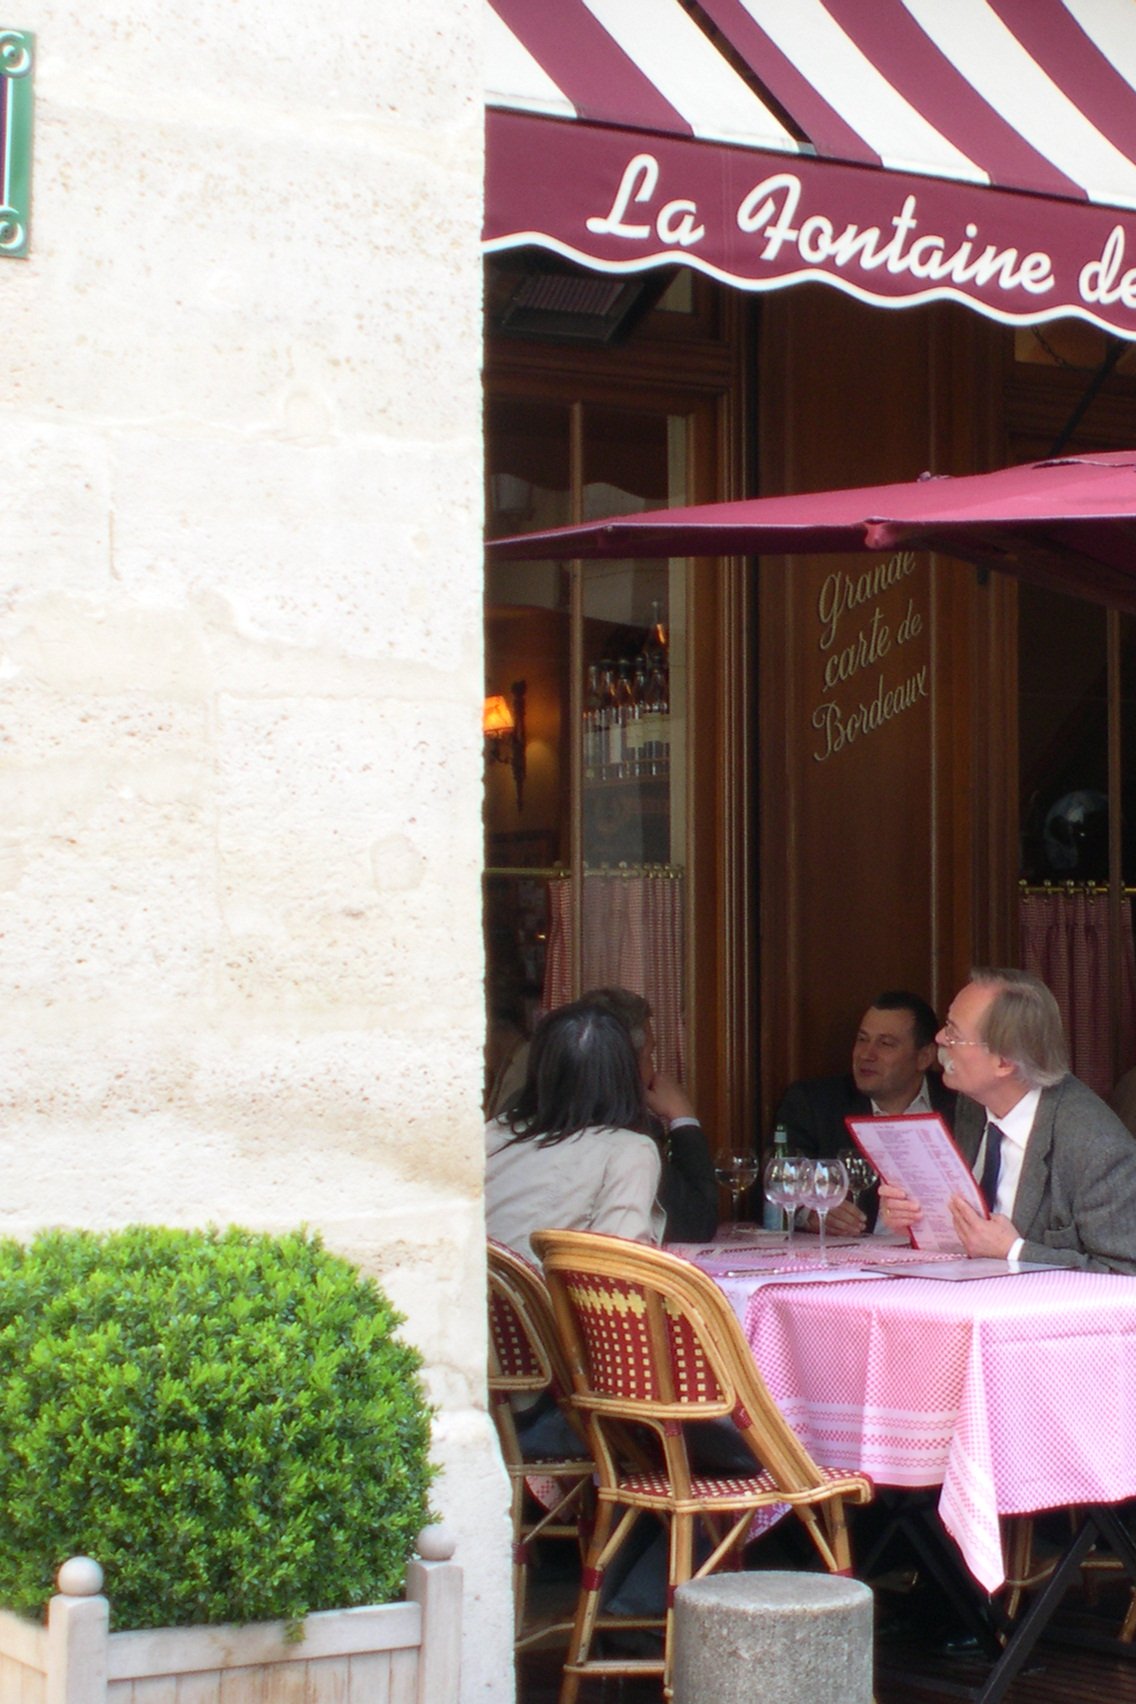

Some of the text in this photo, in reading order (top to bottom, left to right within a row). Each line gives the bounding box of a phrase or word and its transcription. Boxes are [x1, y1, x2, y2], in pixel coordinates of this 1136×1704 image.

[586, 153, 705, 247] La
[737, 173, 1055, 294] Fontaine
[822, 599, 923, 692] carte de
[812, 665, 929, 761] Bordeaux
